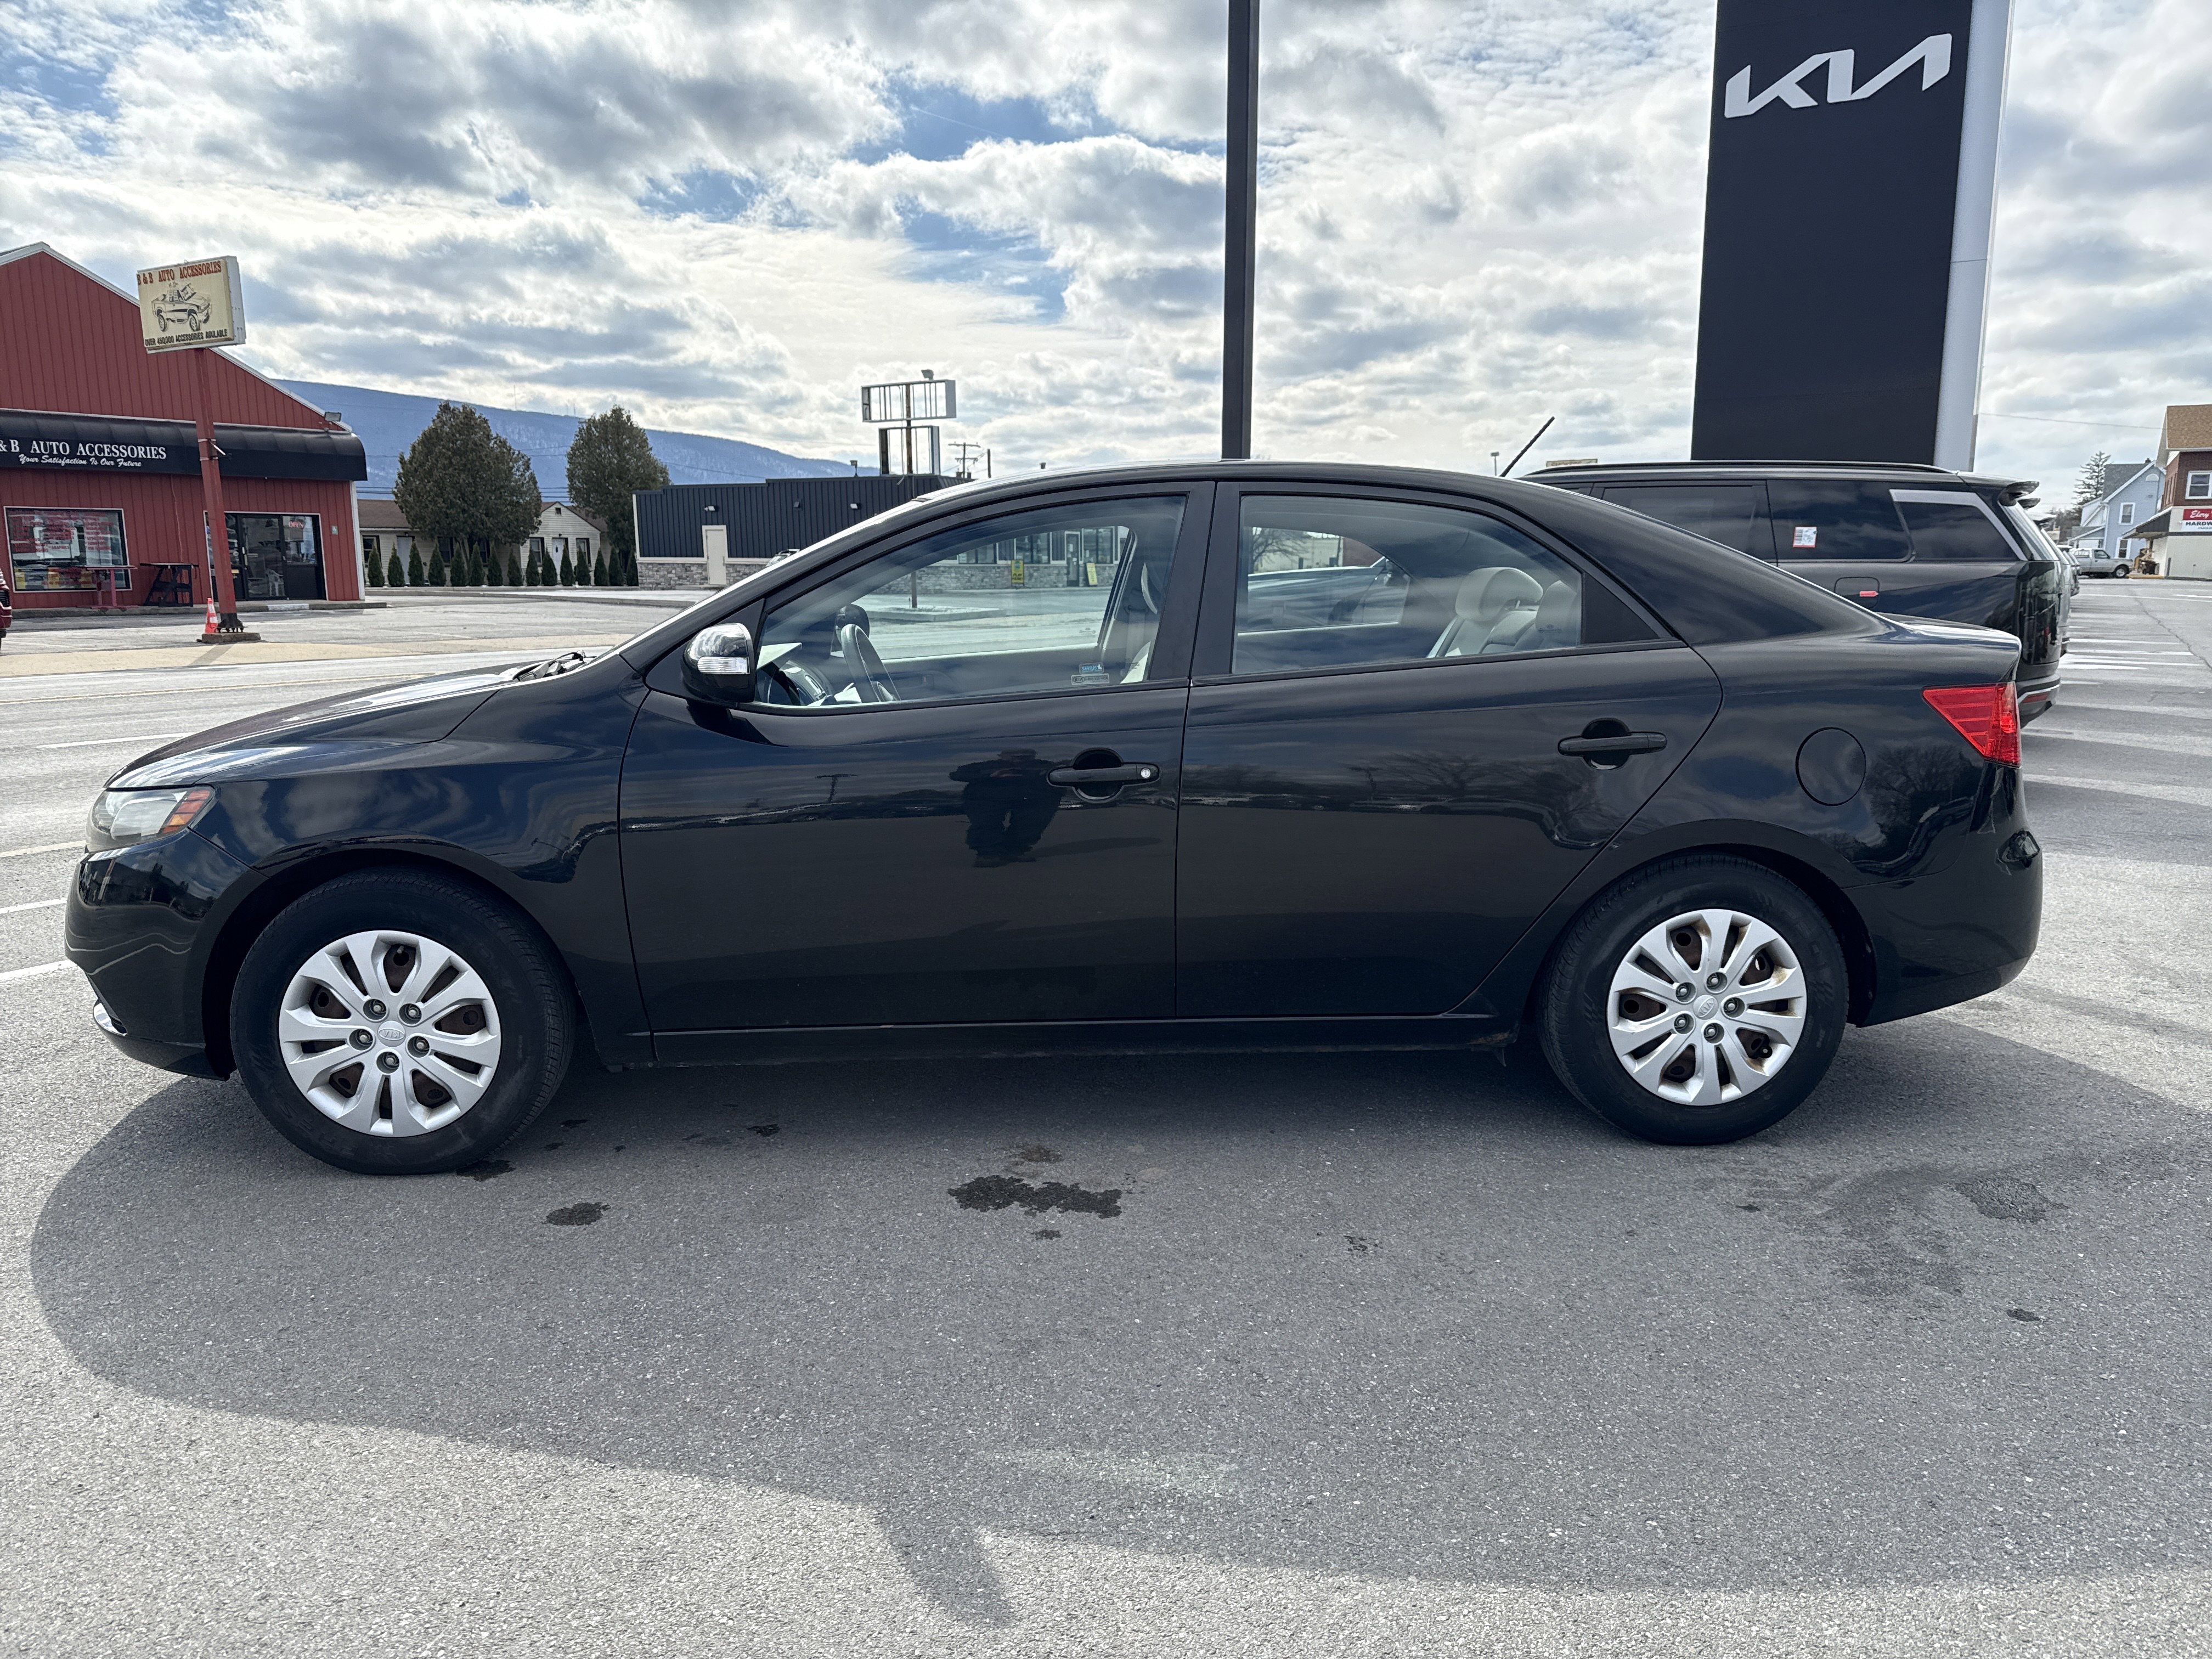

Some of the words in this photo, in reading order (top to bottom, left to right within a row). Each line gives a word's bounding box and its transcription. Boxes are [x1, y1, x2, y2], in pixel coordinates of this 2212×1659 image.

[137, 274, 141, 285] B
[143, 273, 148, 284] &
[148, 272, 153, 284] B
[158, 268, 174, 282] AUTO
[179, 260, 222, 279] ACCESSORIES
[145, 338, 156, 346] OVER
[176, 332, 204, 342] ACCESSORIES
[205, 329, 228, 338] AVAILABLE
[9, 439, 19, 453] B
[30, 441, 70, 455] AUTO
[77, 443, 166, 459] ACCESSORIES
[18, 454, 40, 464] Your
[41, 455, 87, 466] Satisfaction
[89, 457, 98, 465] Is
[100, 458, 115, 466] Our
[116, 459, 142, 467] Future
[1699, 998, 1714, 1015] KIA
[381, 1029, 402, 1039] KIA
